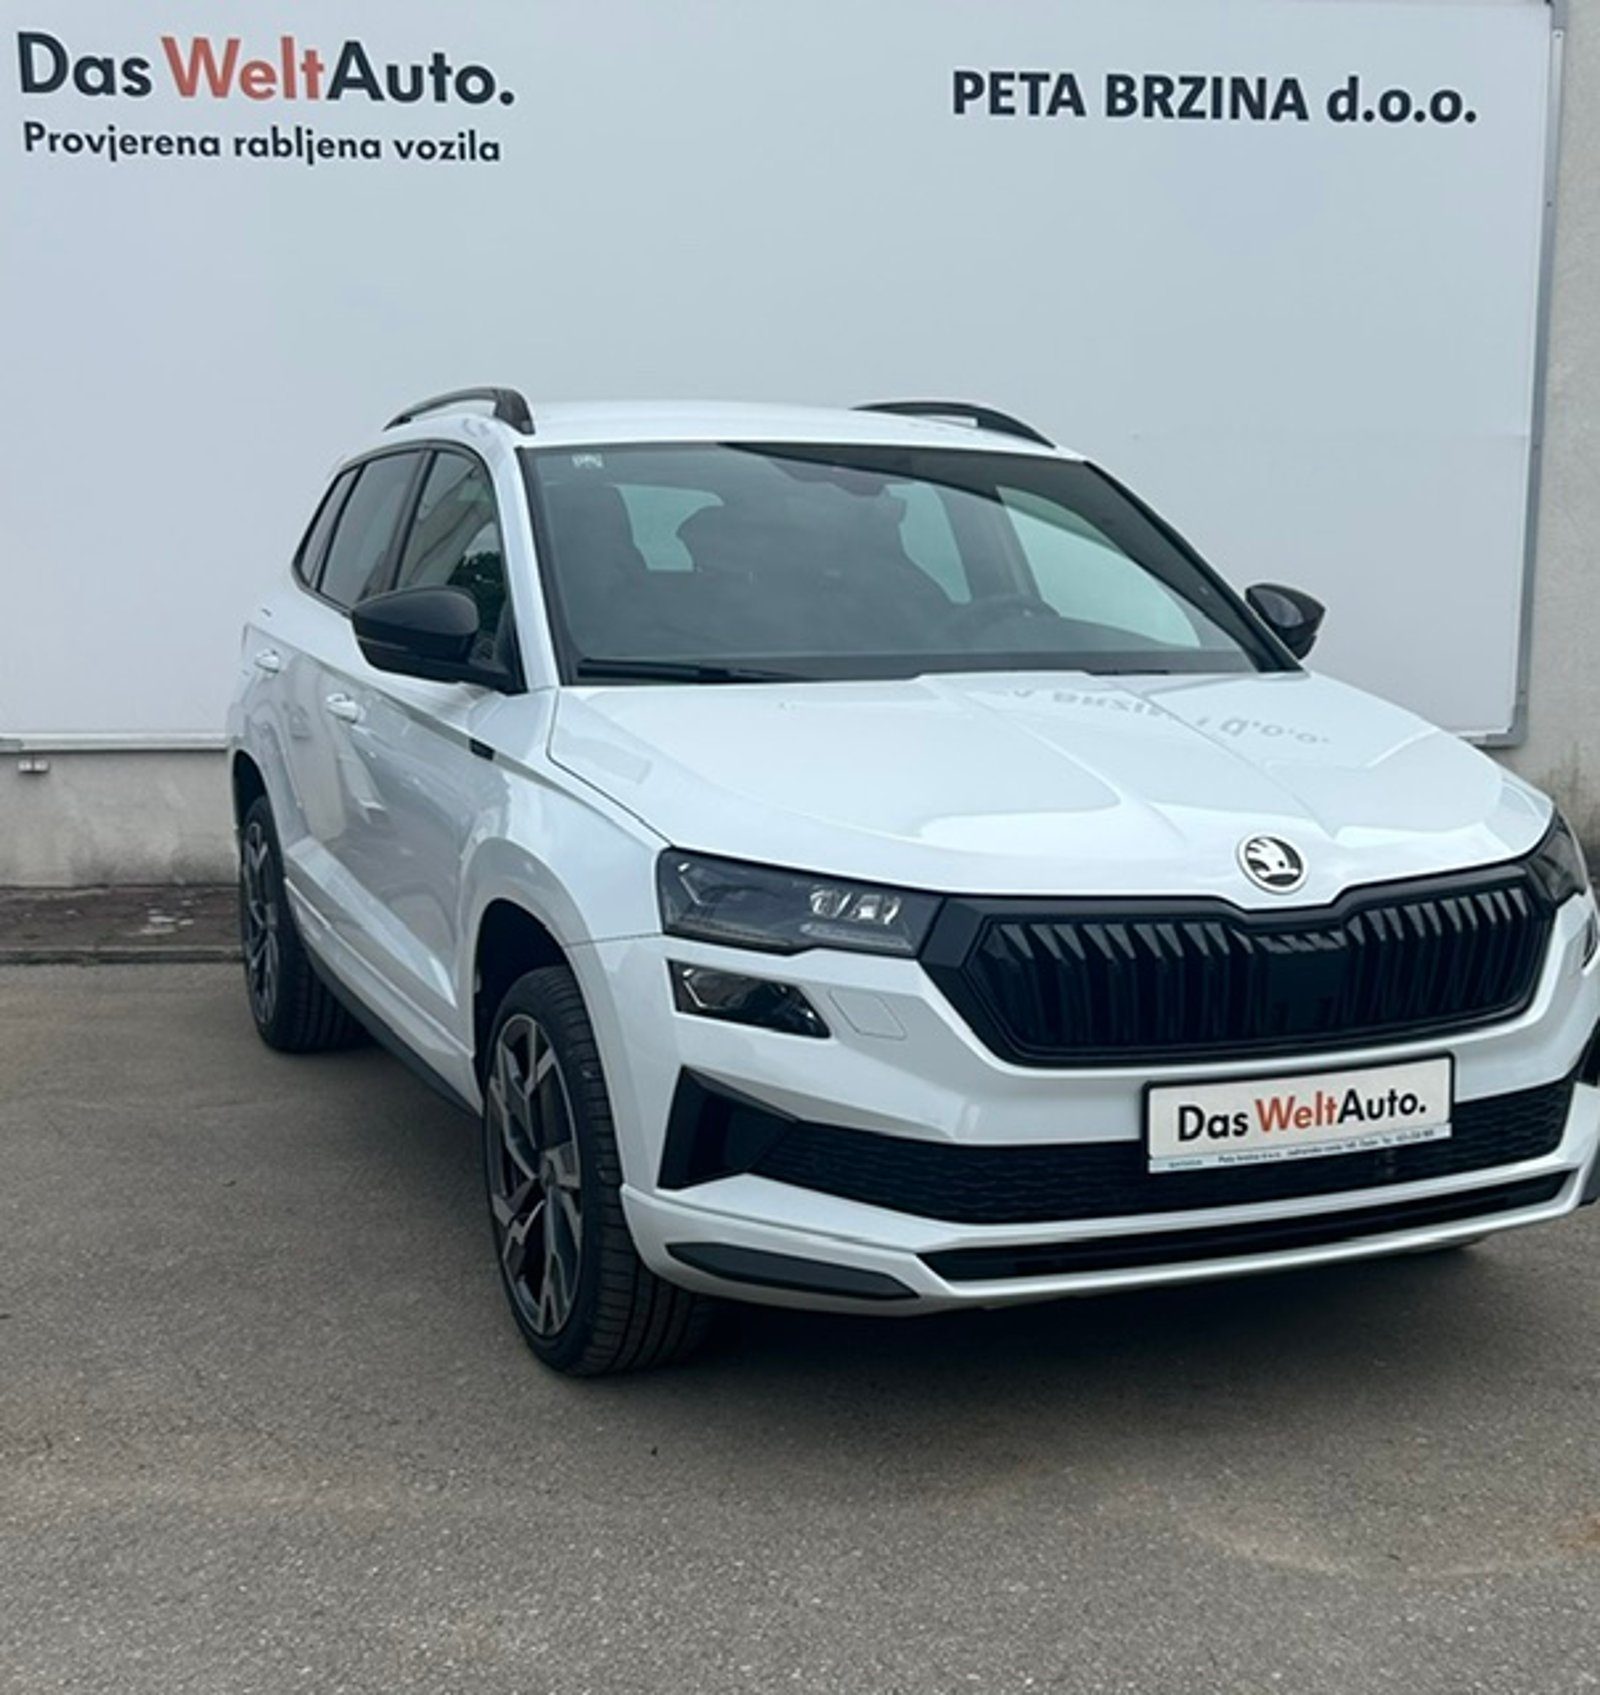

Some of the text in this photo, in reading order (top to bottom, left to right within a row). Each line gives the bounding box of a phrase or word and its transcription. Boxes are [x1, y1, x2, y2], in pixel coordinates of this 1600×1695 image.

[17, 31, 516, 106] Das WeltAuto.
[953, 70, 1477, 124] PETA BRZINA d.o.o.
[23, 120, 501, 167] Provjerena rabljena vozila
[1178, 1088, 1427, 1142] Das WeltAuto.
